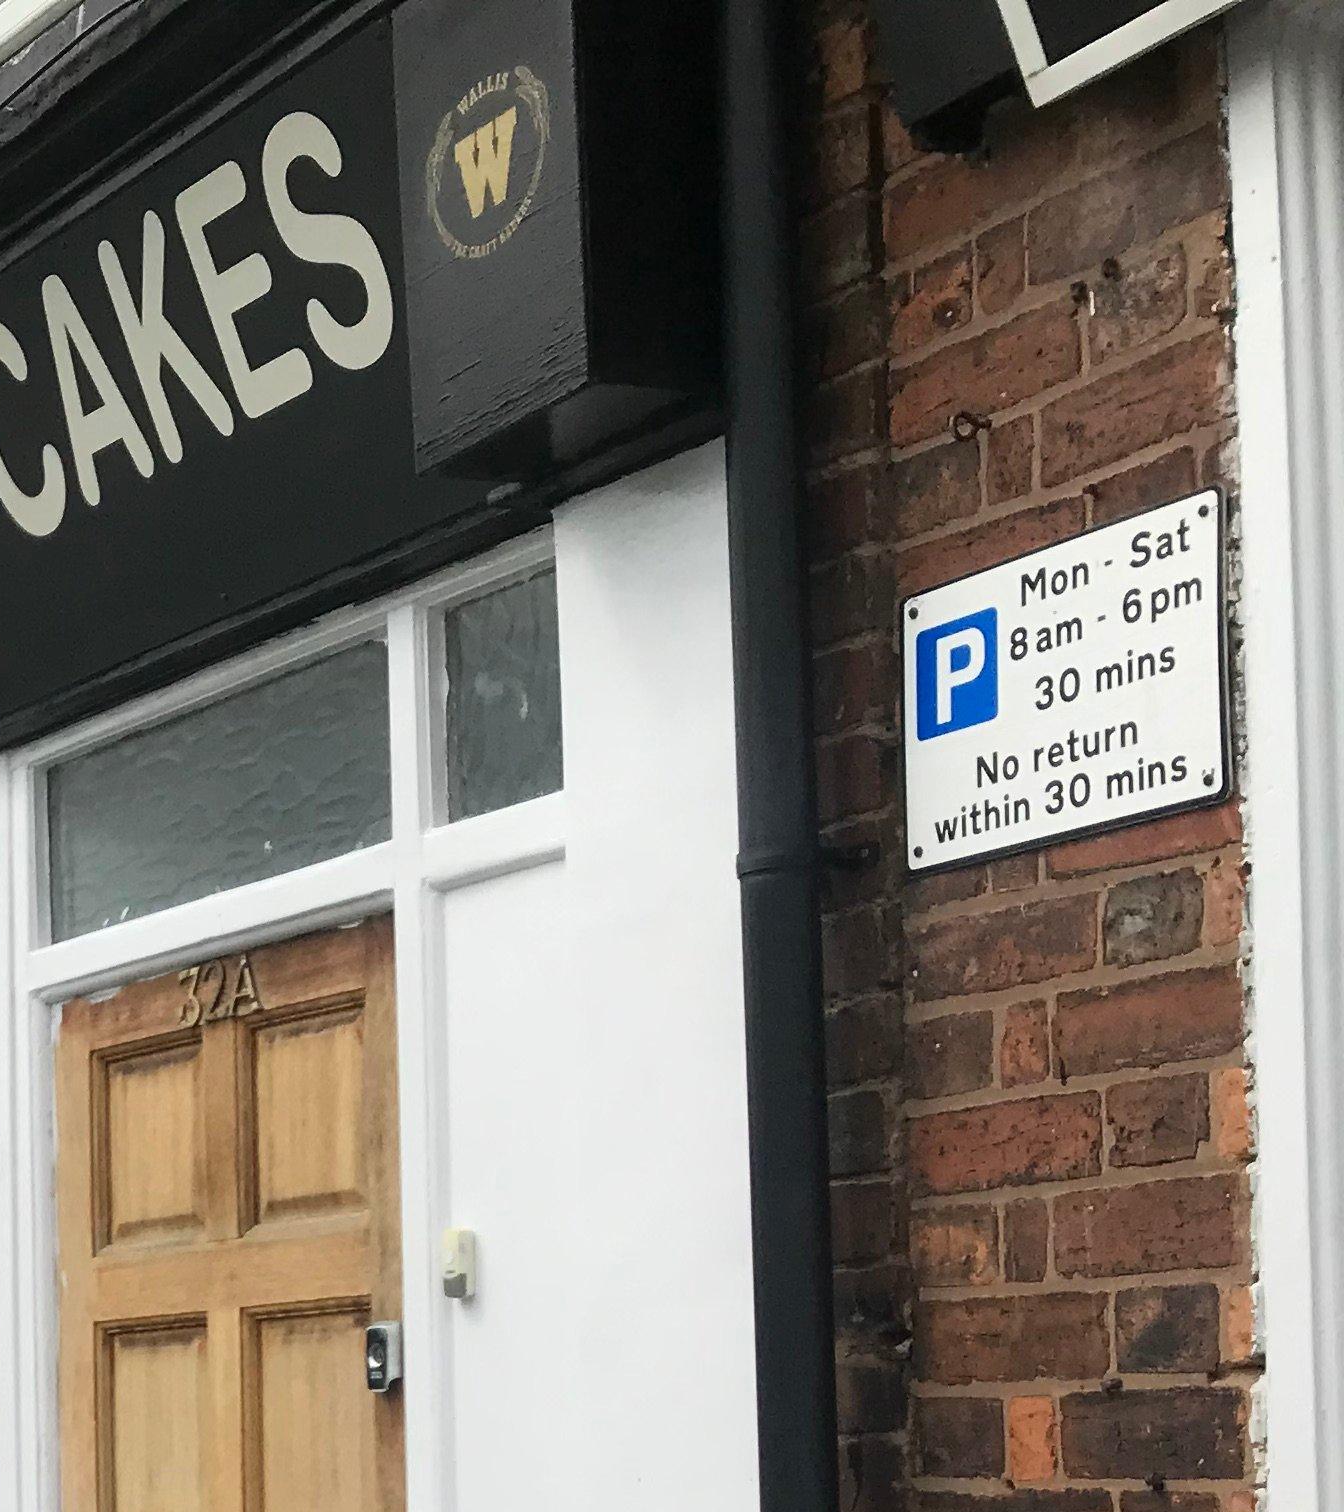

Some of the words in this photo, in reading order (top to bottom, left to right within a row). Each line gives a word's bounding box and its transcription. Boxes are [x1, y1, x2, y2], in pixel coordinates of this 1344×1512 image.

[457, 72, 509, 115] WALLIS
[455, 105, 517, 219] W
[1021, 561, 1090, 606] Mon
[1129, 518, 1191, 569] Sat
[935, 627, 986, 726] P
[1035, 667, 1080, 711] 30
[1095, 645, 1176, 693] mins
[976, 751, 1019, 788] No
[1033, 719, 1139, 773] return
[934, 794, 1031, 844] within
[1044, 772, 1091, 816] 30
[1106, 755, 1187, 800] mins
[178, 955, 263, 1027] 32A
